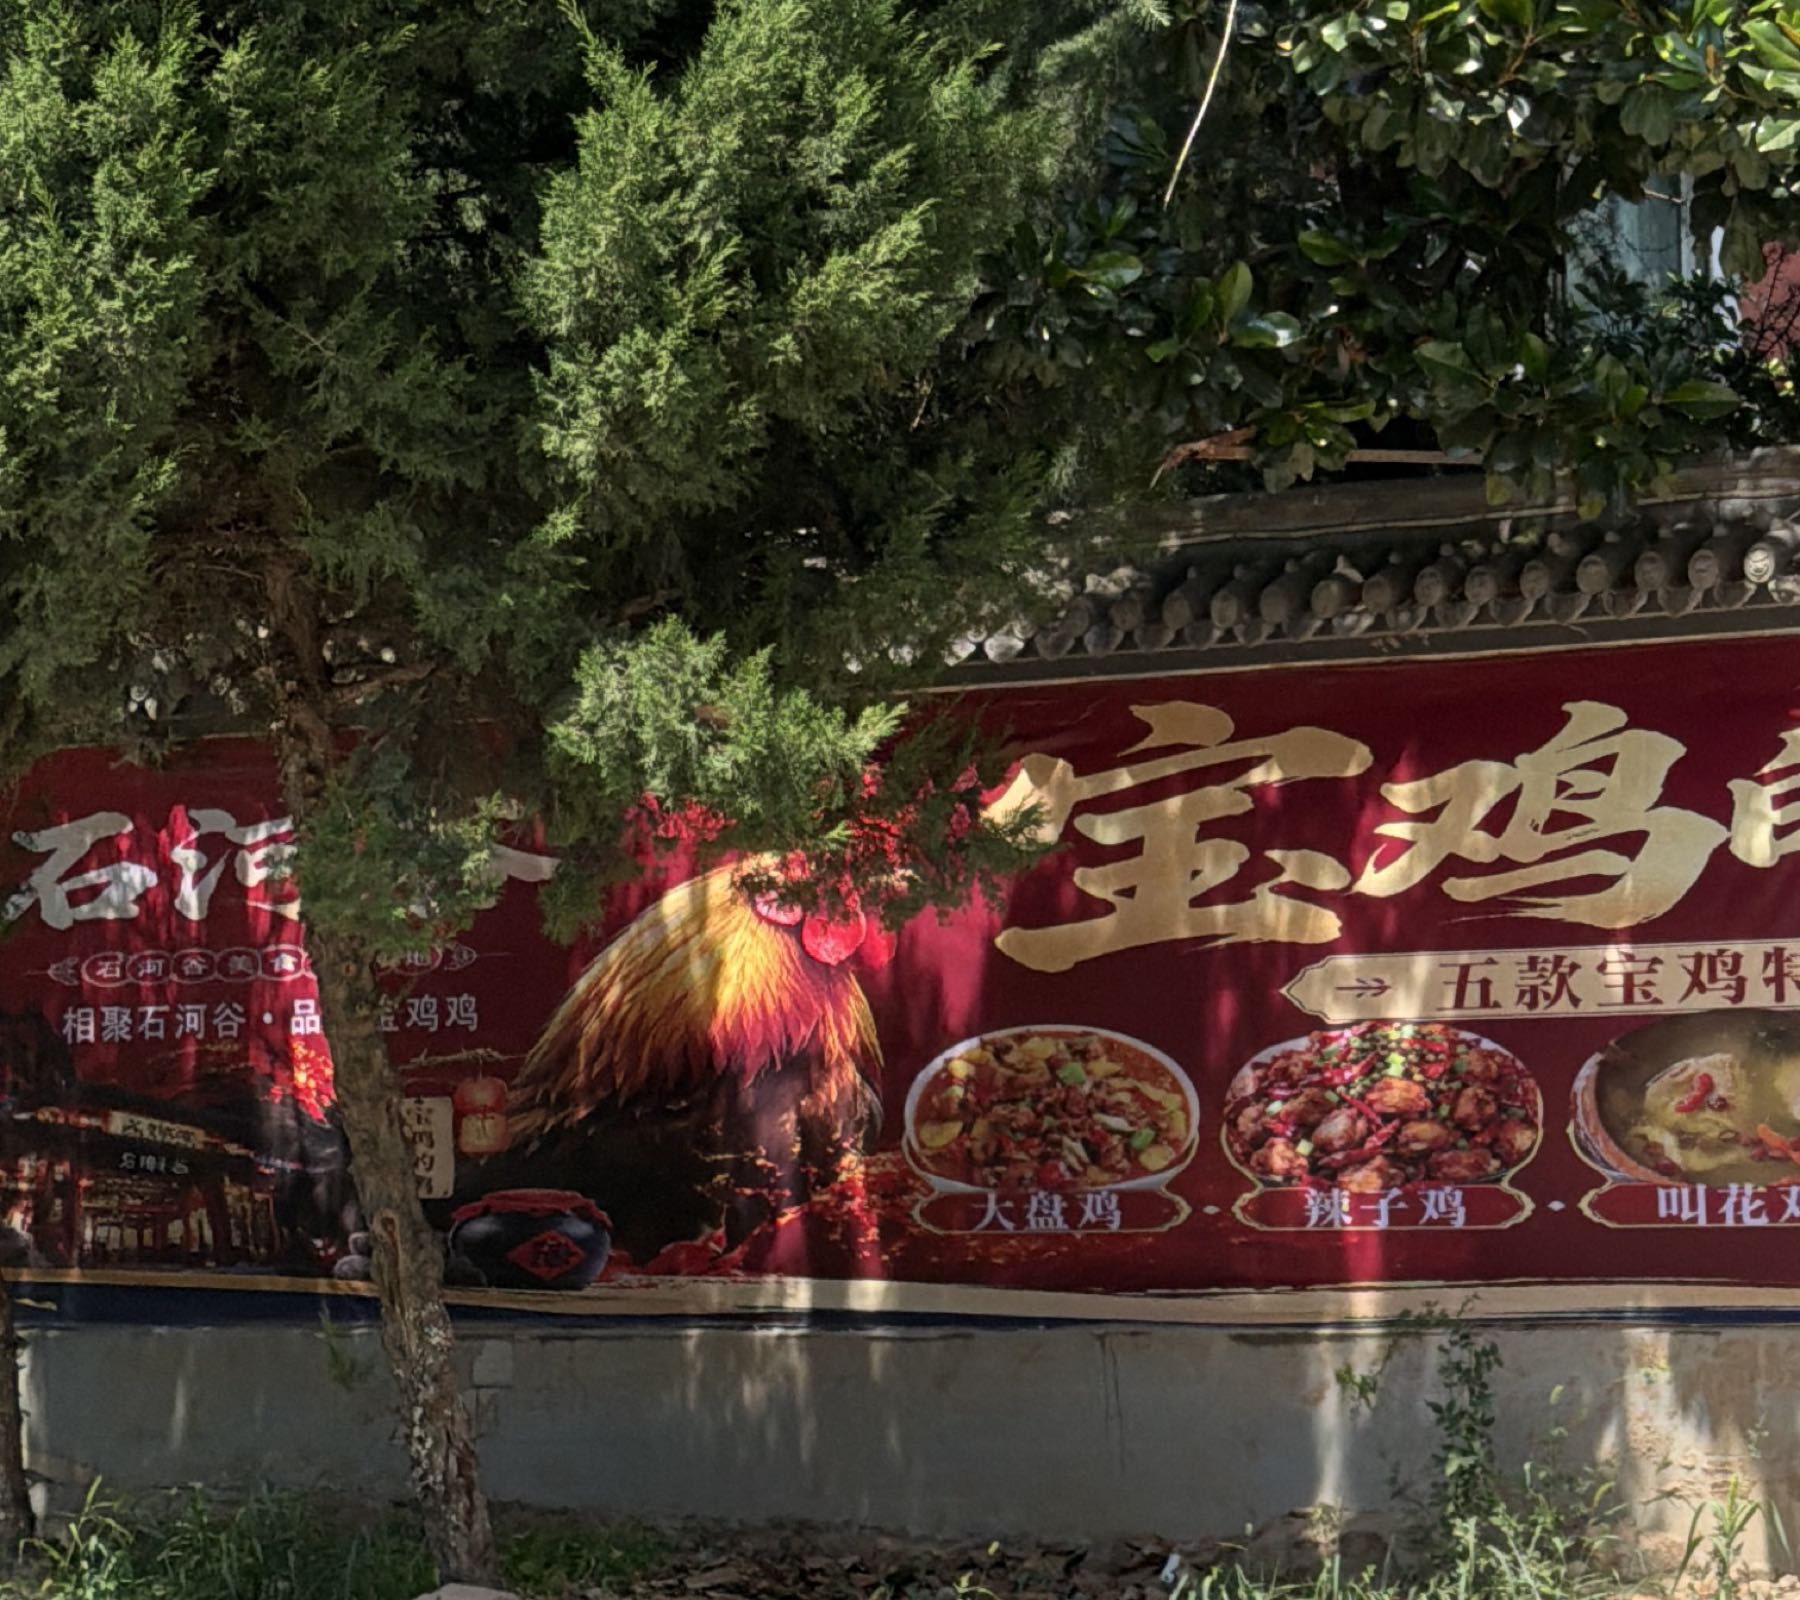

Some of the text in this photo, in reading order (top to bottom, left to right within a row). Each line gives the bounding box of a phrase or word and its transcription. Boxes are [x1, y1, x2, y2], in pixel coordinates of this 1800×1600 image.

[63, 993, 479, 1045] 相聚石河谷·品鸡鸡
[970, 1191, 1123, 1232] 大盘鸡
[1303, 1185, 1467, 1229] 辣子鸡
